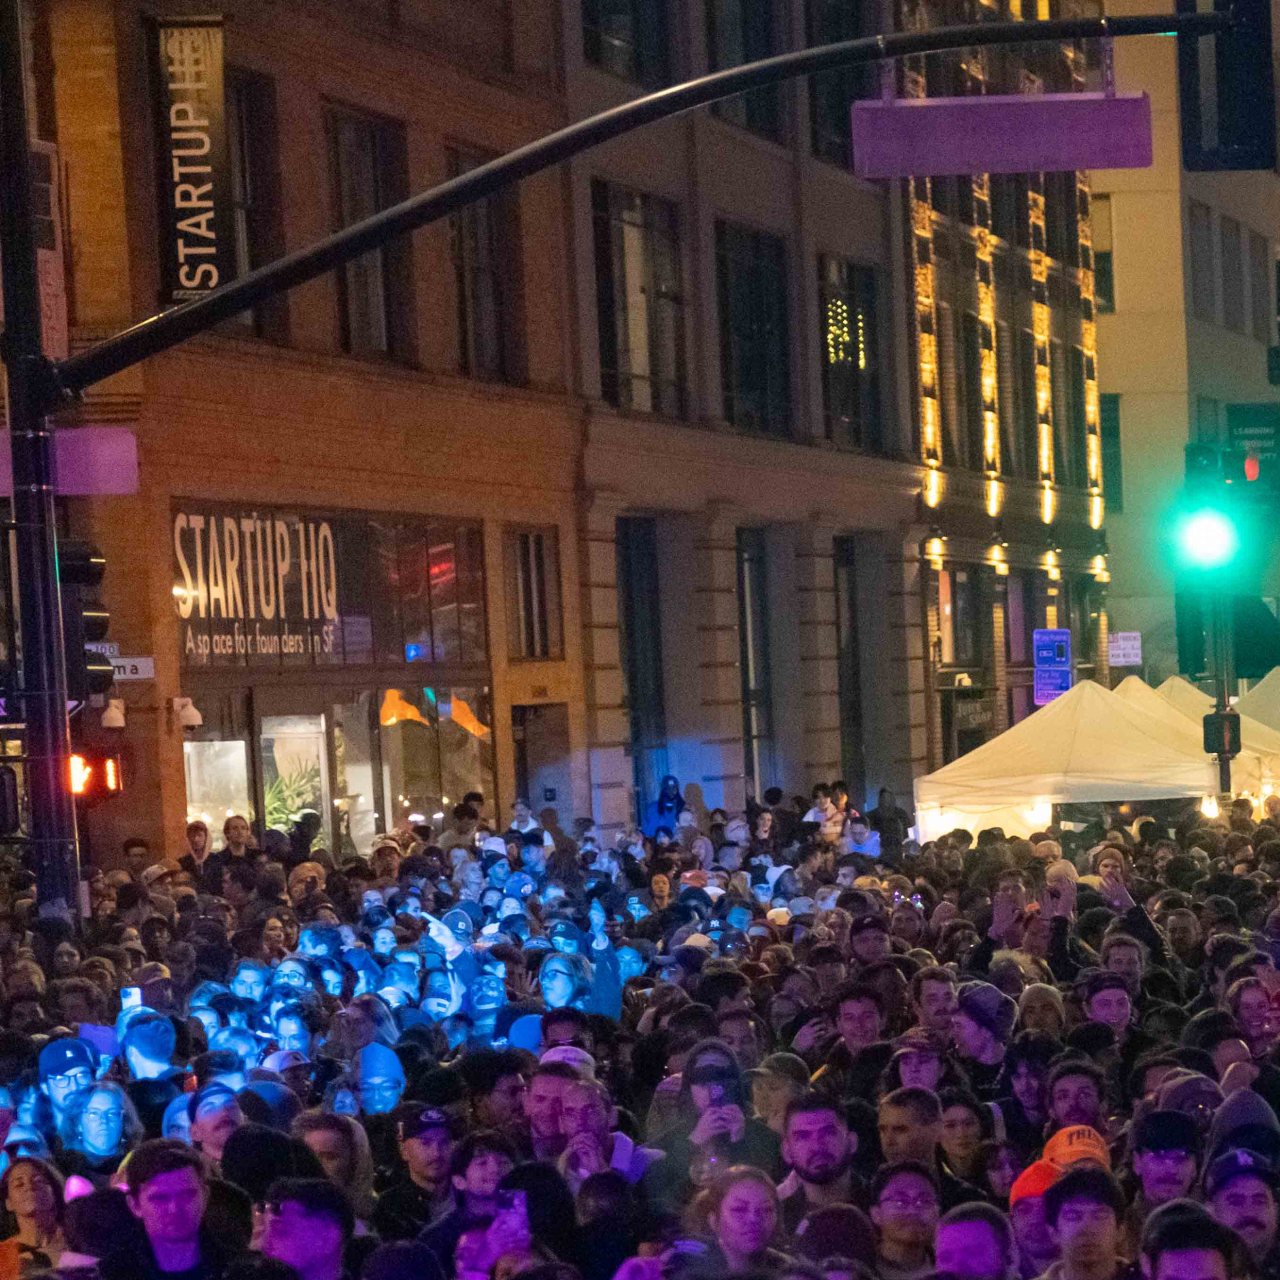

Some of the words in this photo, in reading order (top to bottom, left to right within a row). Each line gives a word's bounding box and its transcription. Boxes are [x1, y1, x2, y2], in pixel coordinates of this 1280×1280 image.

[170, 102, 219, 289] STARTUP
[174, 512, 291, 619] STARTUP
[299, 522, 340, 622] HQ
[185, 624, 196, 653] A
[197, 632, 233, 664] space
[234, 622, 252, 654] for
[255, 622, 304, 654] founders
